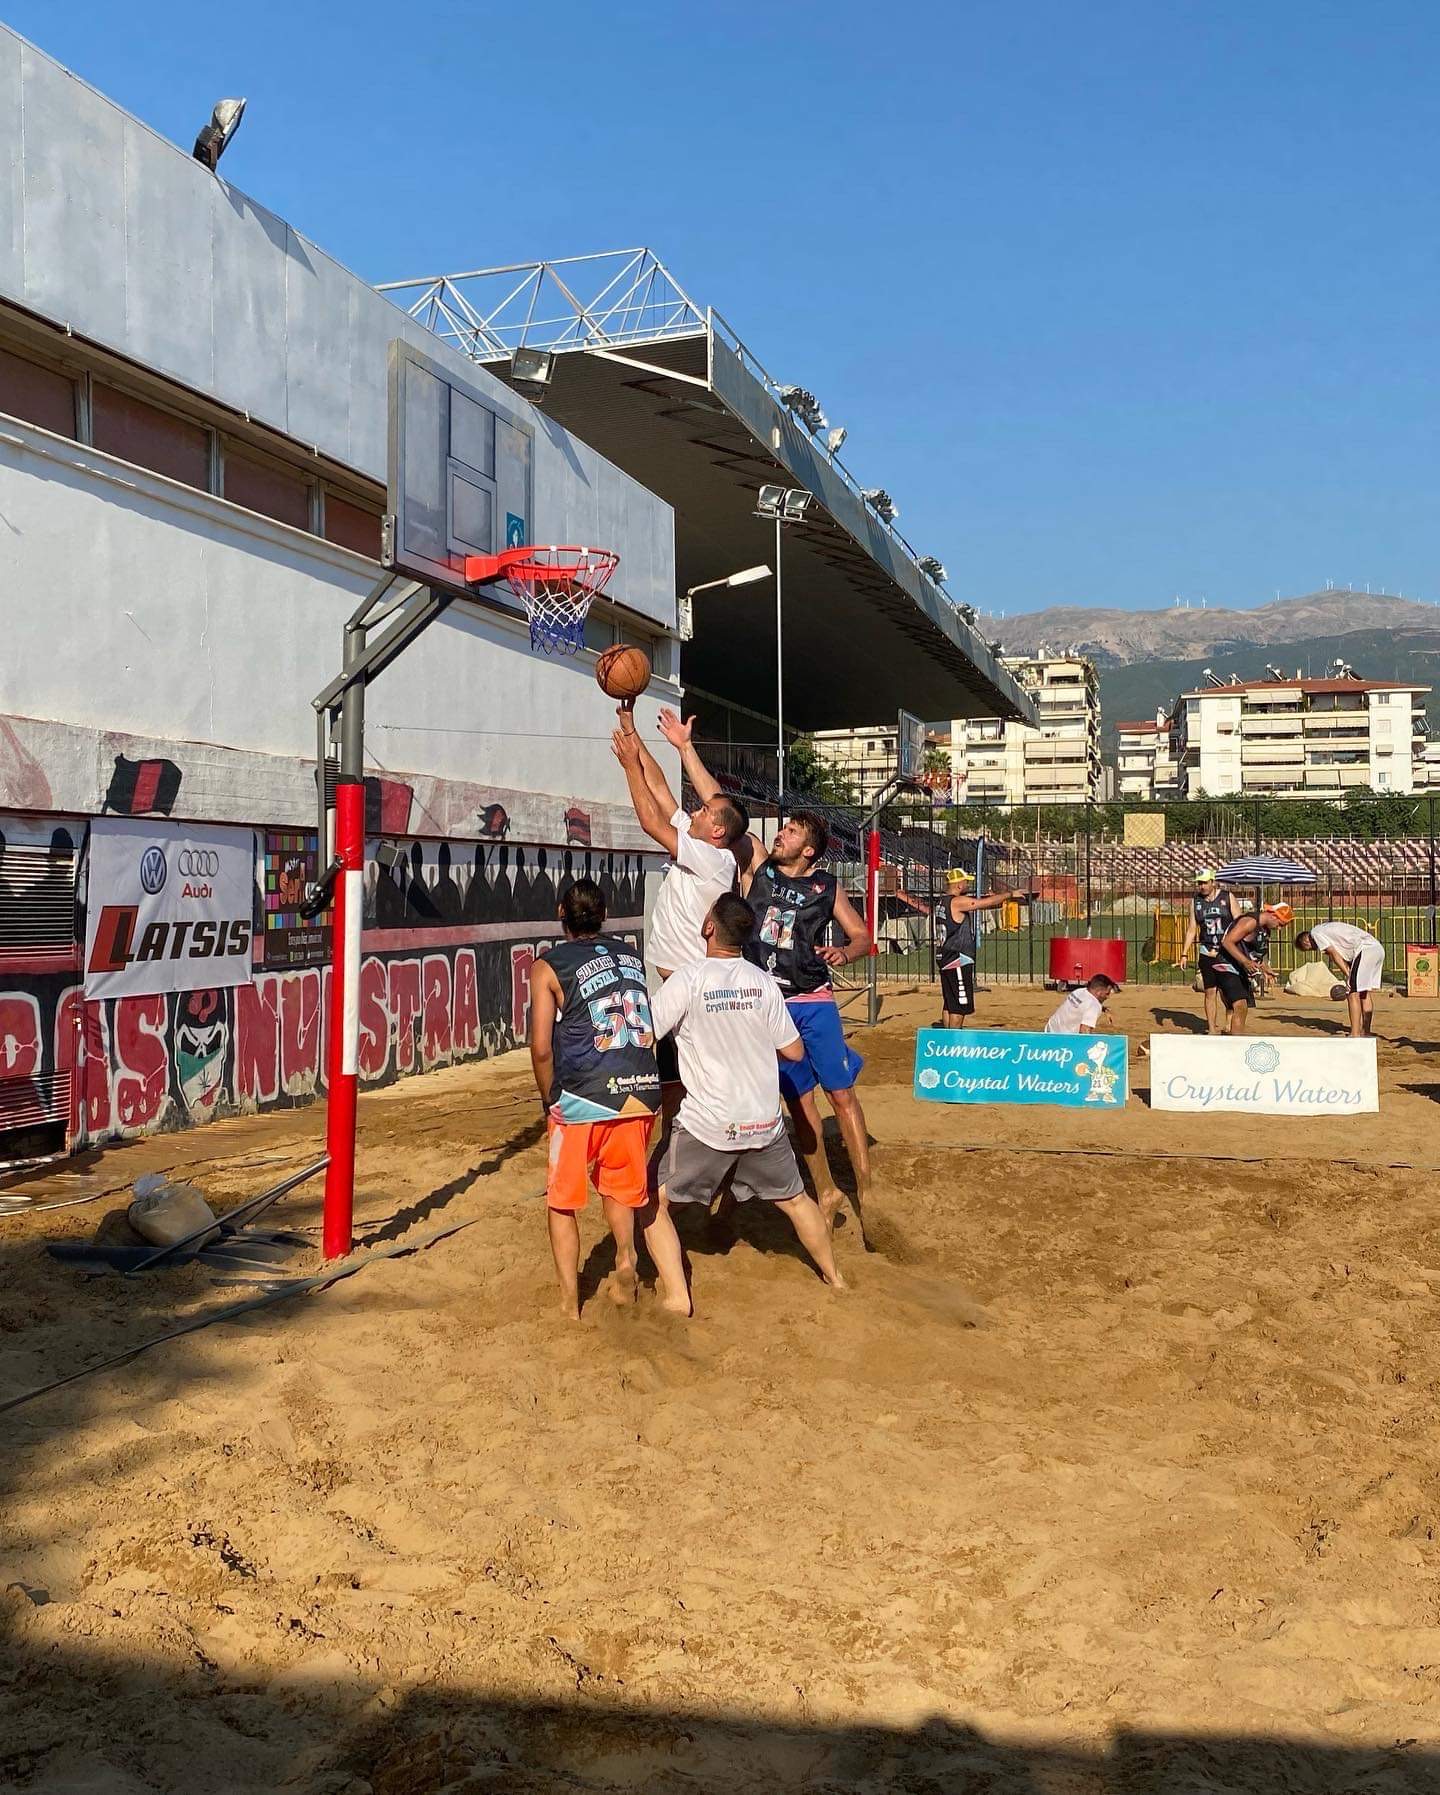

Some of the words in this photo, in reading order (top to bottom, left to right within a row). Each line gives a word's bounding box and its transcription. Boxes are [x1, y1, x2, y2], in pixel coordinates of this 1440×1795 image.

[182, 883, 213, 899] Audi
[88, 905, 252, 973] LATSIS
[575, 955, 616, 984] SUMMER
[233, 948, 481, 1102] NUSTRA
[587, 989, 654, 1053] 59
[924, 1040, 1011, 1060] Summer
[1011, 1043, 1074, 1069] Jump
[943, 1070, 1010, 1095] Crystal
[1018, 1073, 1081, 1095] Waters
[1166, 1075, 1264, 1107] Crystal
[1272, 1078, 1363, 1105] Waters
